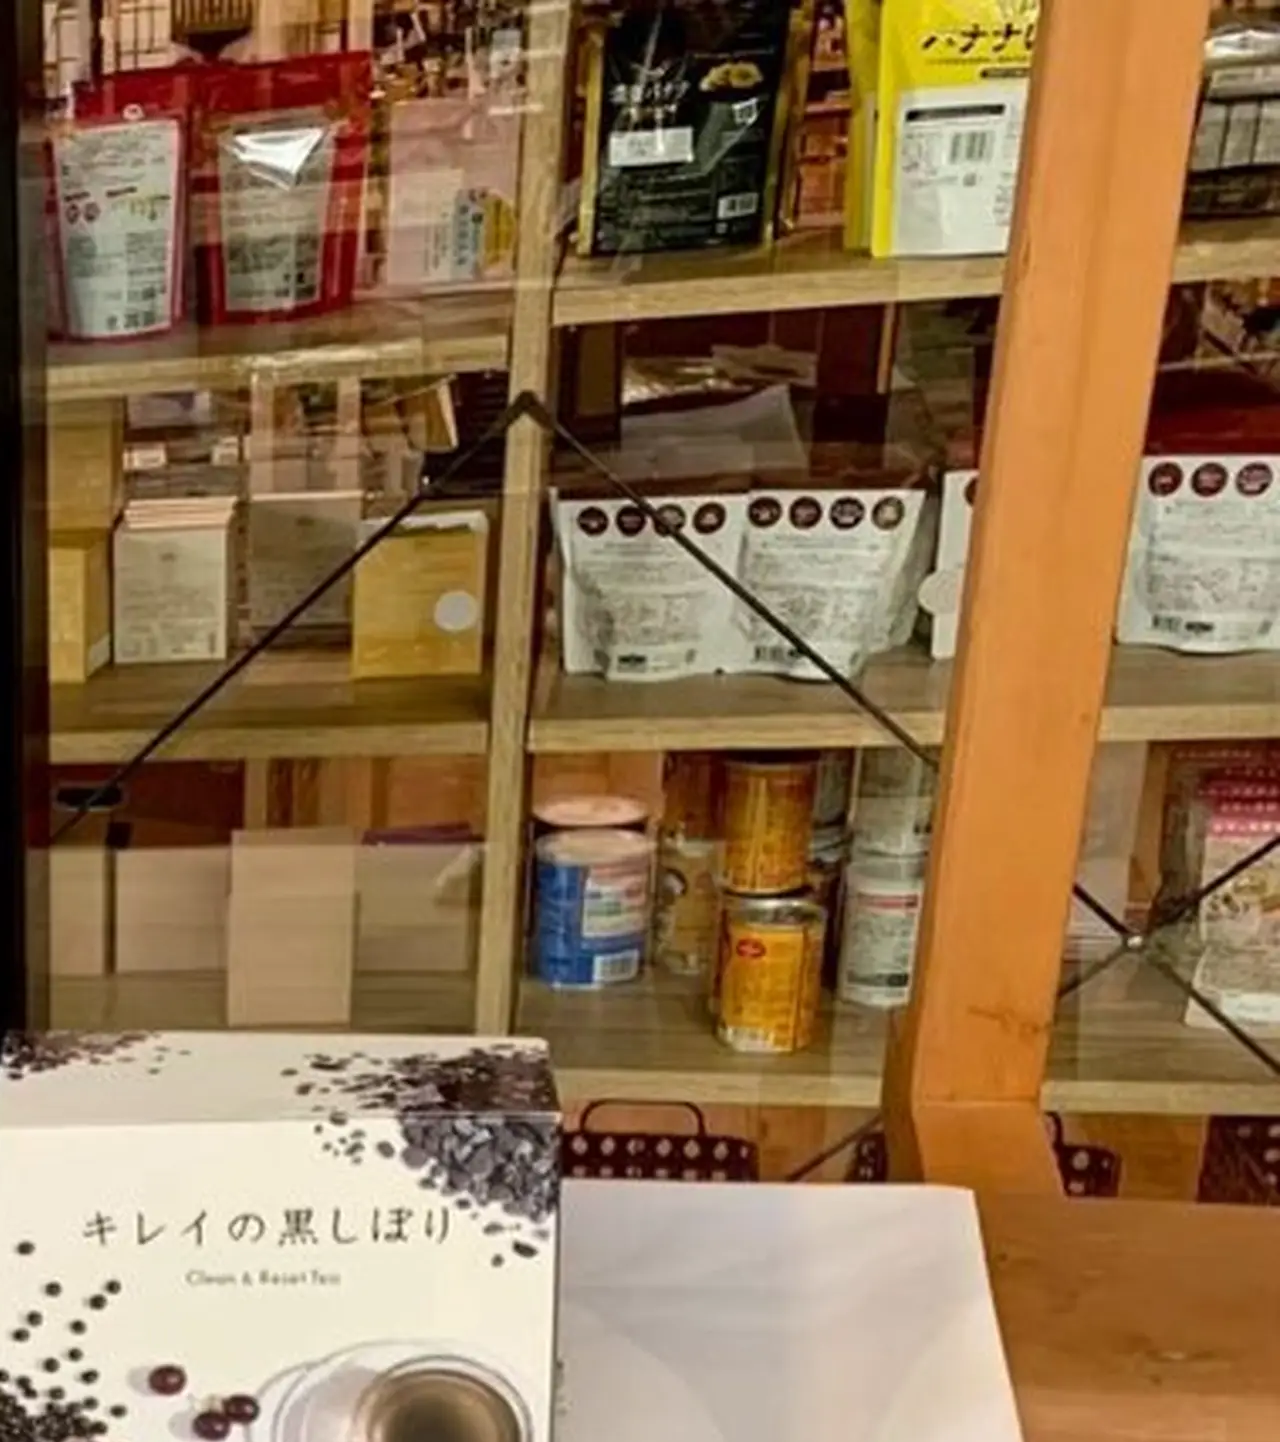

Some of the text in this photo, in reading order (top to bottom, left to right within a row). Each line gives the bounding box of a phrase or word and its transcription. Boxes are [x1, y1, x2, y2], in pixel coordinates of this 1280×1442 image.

[82, 1206, 452, 1248] キレイの黒しぼり
